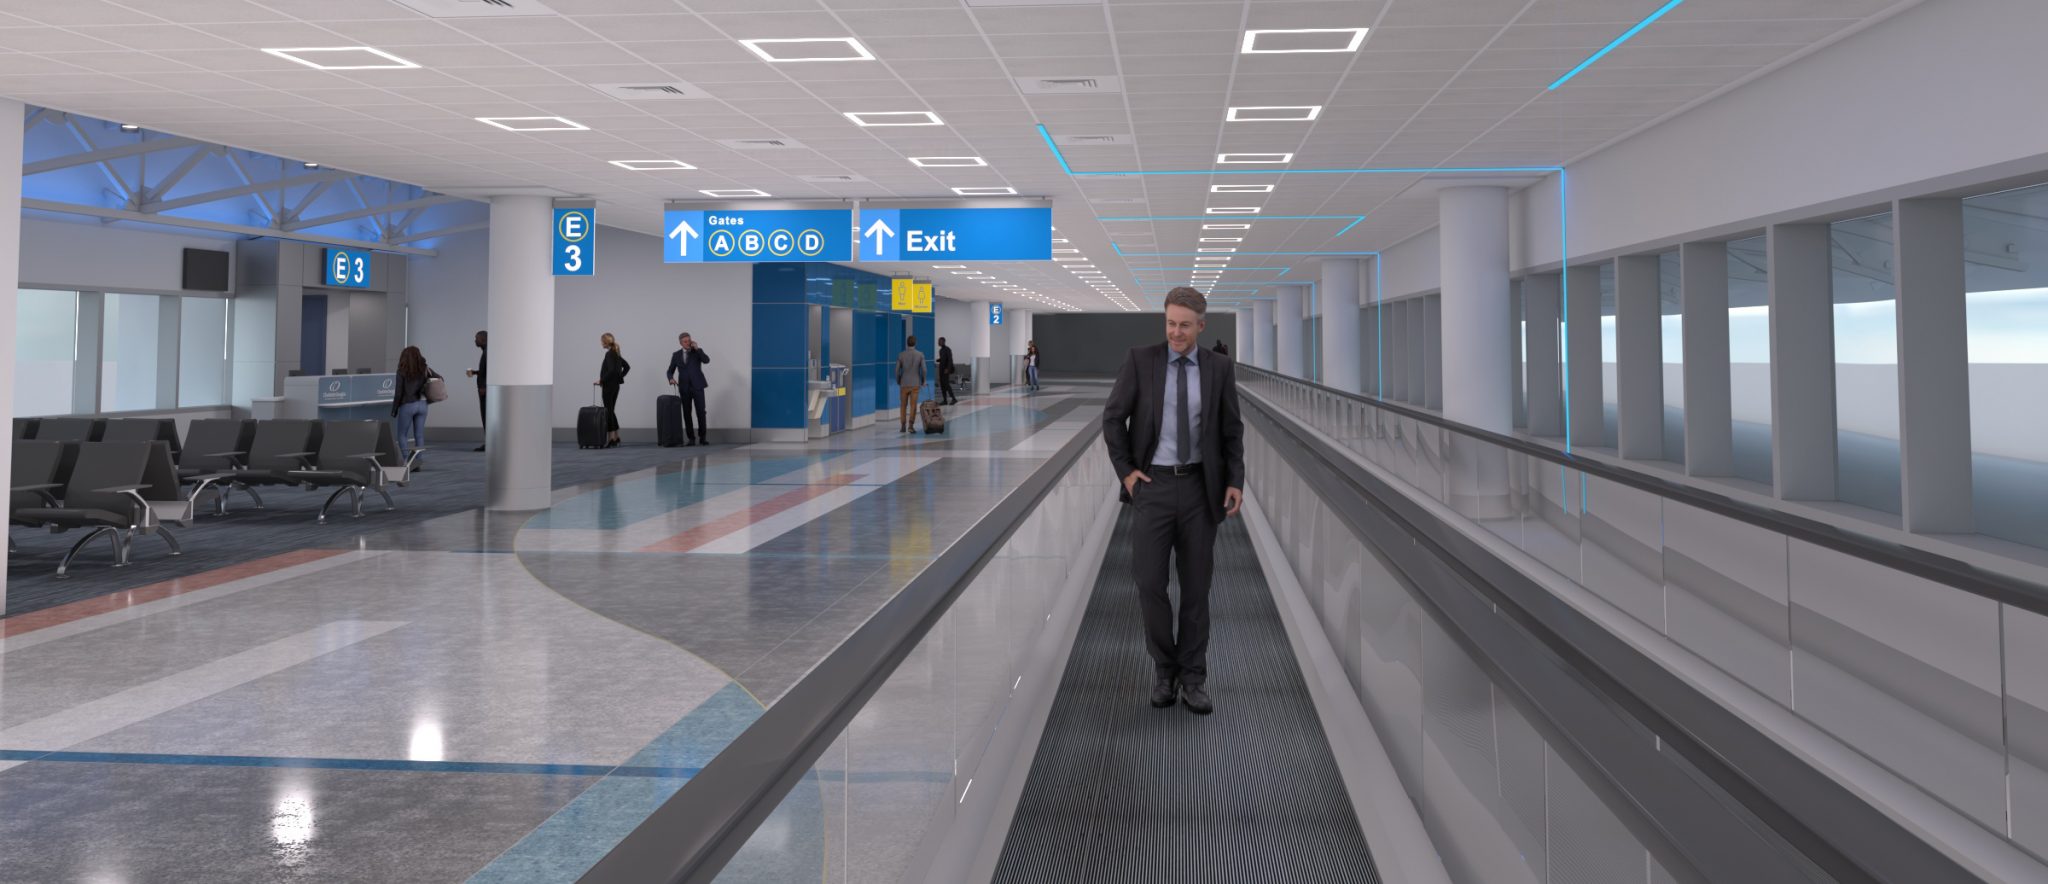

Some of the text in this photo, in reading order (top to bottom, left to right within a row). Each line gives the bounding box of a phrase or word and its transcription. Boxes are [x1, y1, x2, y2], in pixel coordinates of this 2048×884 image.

[566, 216, 582, 237] E
[708, 215, 744, 226] Gates
[714, 234, 819, 251] A B C D
[907, 230, 956, 252] Exit
[564, 244, 582, 272] 3
[336, 257, 364, 283] E 3
[993, 315, 1000, 324] 2
